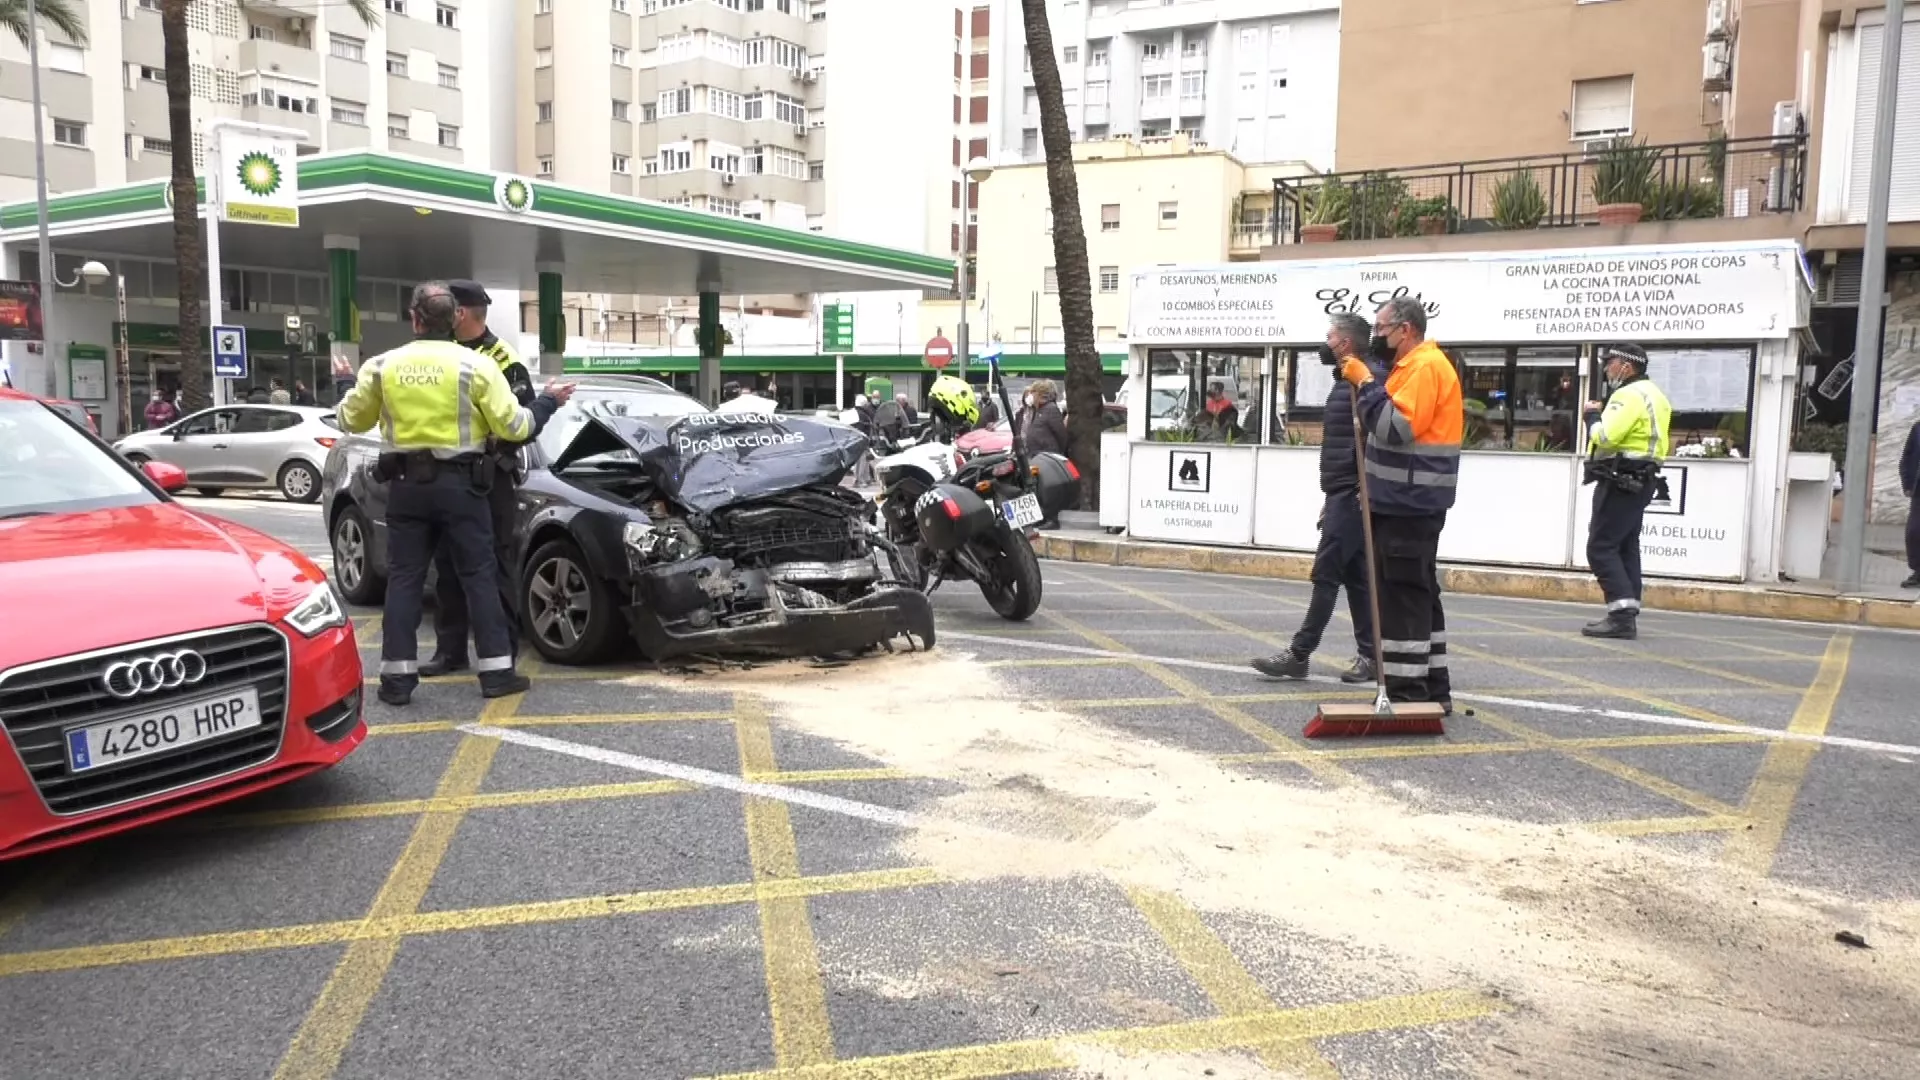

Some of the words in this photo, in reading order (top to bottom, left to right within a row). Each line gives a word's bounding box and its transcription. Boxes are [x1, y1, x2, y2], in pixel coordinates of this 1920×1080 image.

[1506, 265, 1540, 276] GRAN
[1543, 262, 1605, 275] VARIEDAD
[1608, 261, 1625, 272] DE
[1628, 258, 1667, 271] VINOS
[1671, 257, 1698, 270] POR
[1701, 255, 1746, 268] COPAS
[1160, 275, 1218, 286] DESAYUNOS,
[1221, 274, 1278, 284] MERIENDAS
[1543, 279, 1559, 290] LA
[1562, 276, 1610, 289] COCINA
[1613, 273, 1701, 287] TRADICIONAL
[1214, 288, 1220, 297] Y
[1566, 293, 1582, 304] DE
[1586, 291, 1621, 303] TODA
[1625, 290, 1640, 302] LA
[1644, 289, 1675, 301] VIDA
[1162, 302, 1172, 311] 10
[1175, 301, 1215, 311] COMBOS
[1218, 300, 1273, 311] ESPECIALES
[1315, 288, 1362, 314] El
[1503, 307, 1581, 320] PRESENTADA
[1584, 307, 1601, 318] EN
[1604, 305, 1642, 318] TAPAS
[1645, 302, 1744, 316] INNOVADORAS
[1147, 327, 1182, 337] COCINA
[1185, 327, 1222, 337] ABIERTA
[1224, 326, 1252, 336] TODO
[1255, 326, 1265, 336] EL
[1268, 324, 1285, 336] DÍA
[1536, 321, 1618, 334] ELABORADAS
[1622, 320, 1650, 332] CON
[1654, 317, 1705, 331] CARIÑO
[400, 375, 441, 385] LOCAL
[679, 430, 805, 454] Producciones
[1141, 499, 1152, 509] LA
[1193, 502, 1211, 513] DEL
[1214, 503, 1239, 515] LULU
[1164, 517, 1213, 529] GASTROBAR
[1661, 525, 1686, 539] DEL
[1690, 527, 1725, 541] LULU
[1641, 544, 1688, 557] TROBAR
[101, 715, 180, 757] 4280
[193, 698, 245, 736] HRP
[77, 752, 86, 764] E
